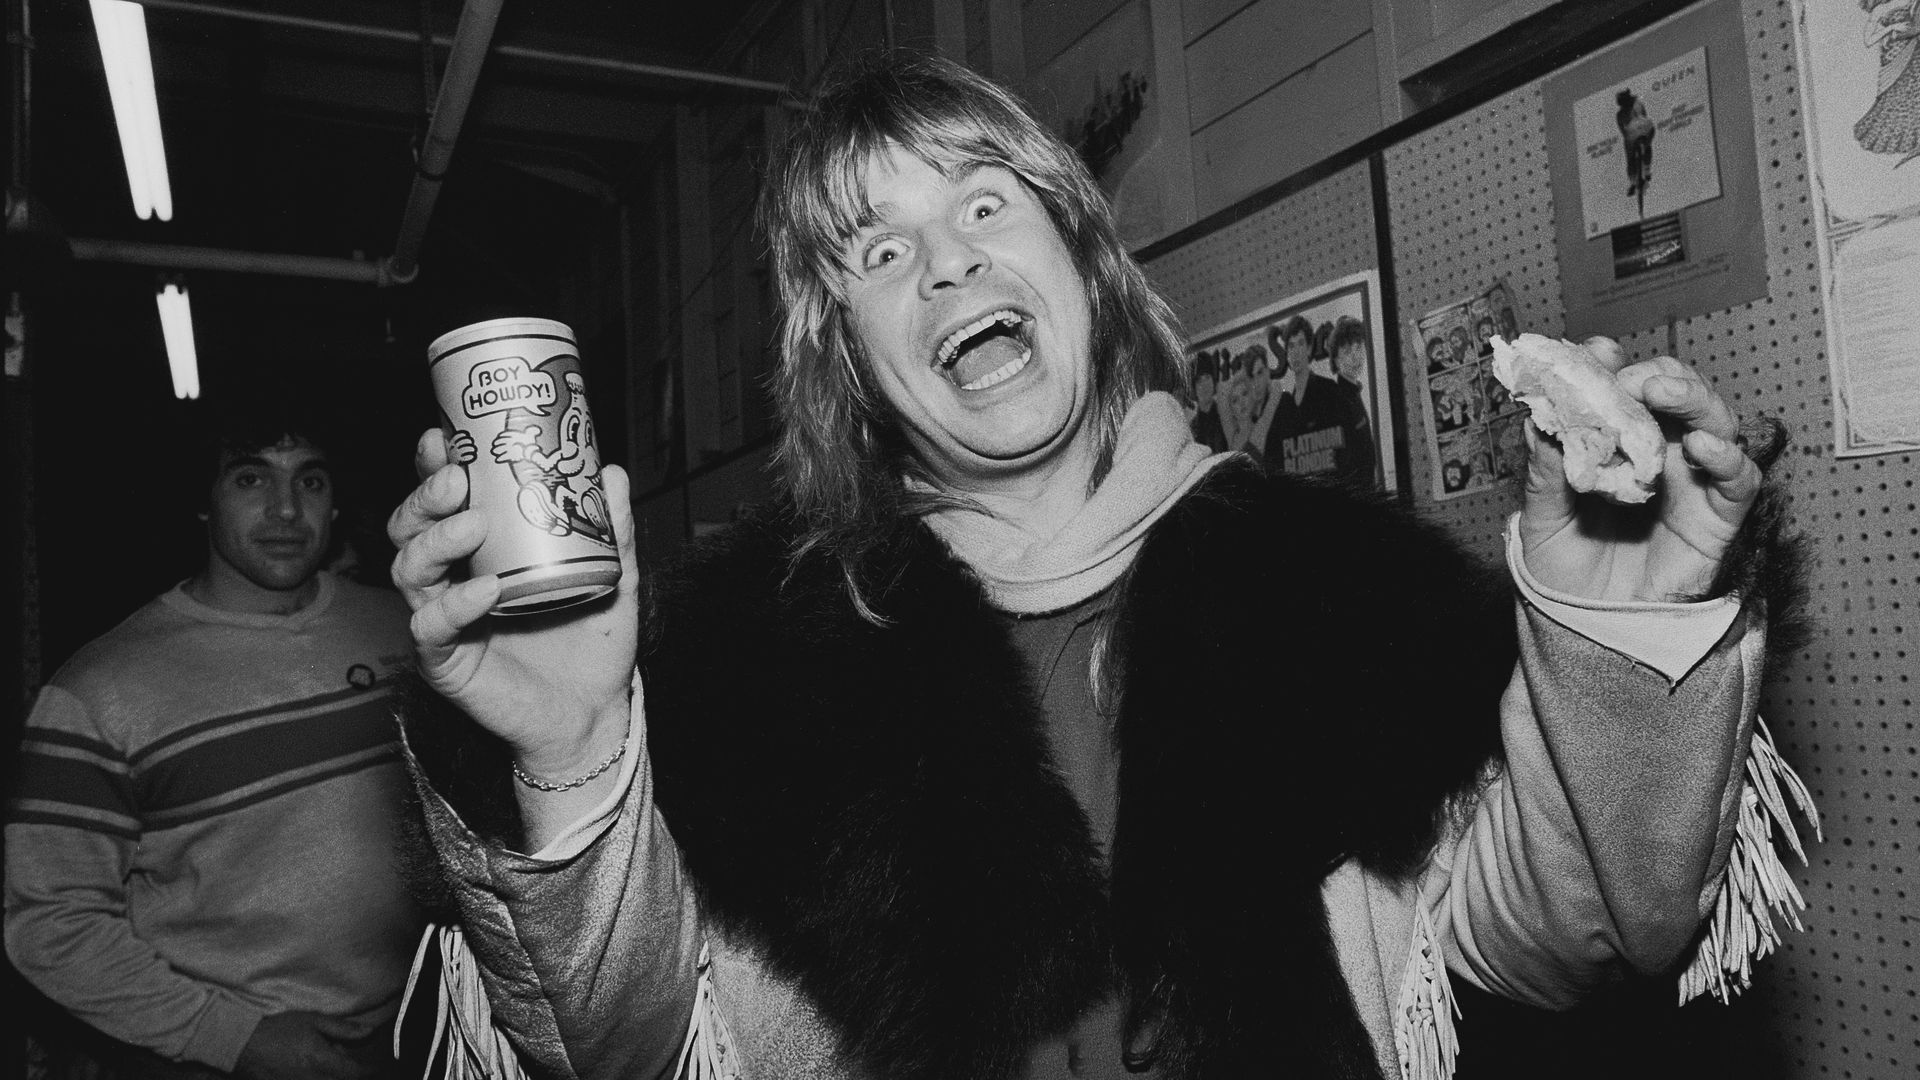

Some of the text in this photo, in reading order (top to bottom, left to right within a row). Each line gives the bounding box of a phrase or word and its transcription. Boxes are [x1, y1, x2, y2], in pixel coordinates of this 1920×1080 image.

[1652, 65, 1696, 92] QUEEN
[479, 366, 520, 388] BOY
[469, 383, 551, 410] HOWDY!
[1283, 425, 1344, 458] PLATINUM
[1284, 449, 1336, 475] BLONDIE
